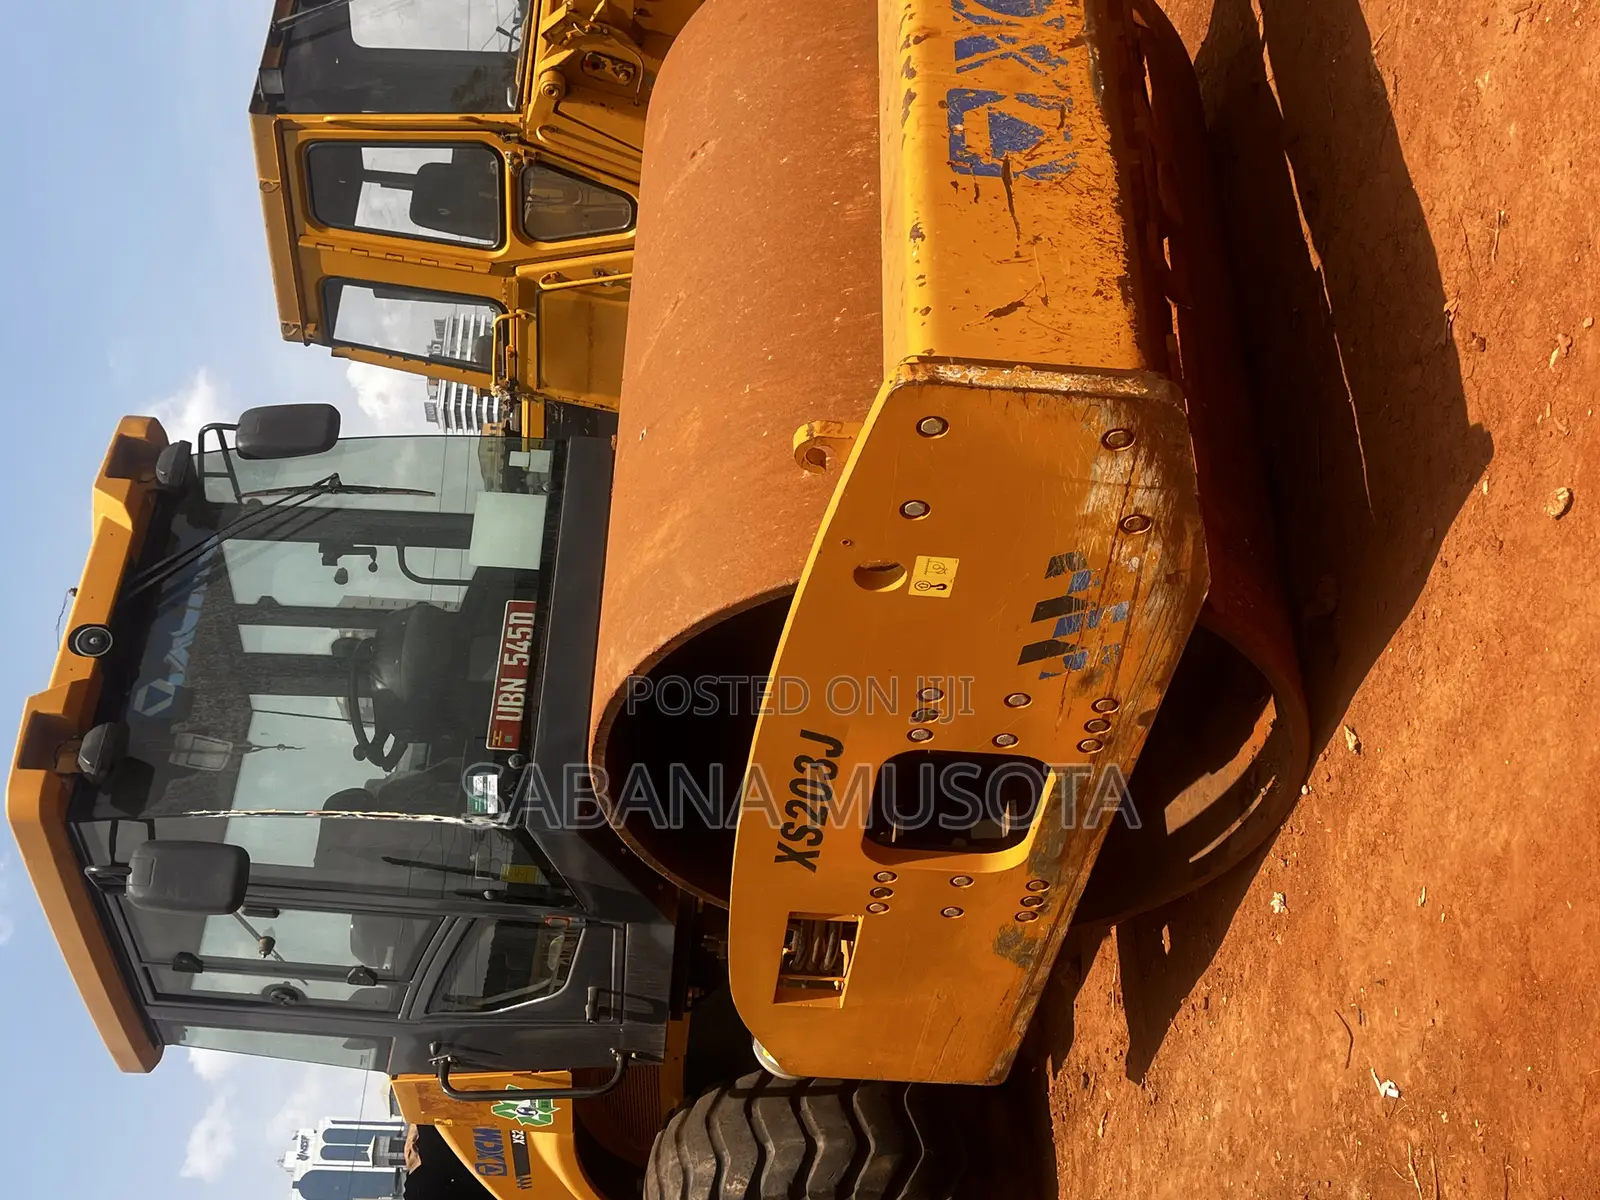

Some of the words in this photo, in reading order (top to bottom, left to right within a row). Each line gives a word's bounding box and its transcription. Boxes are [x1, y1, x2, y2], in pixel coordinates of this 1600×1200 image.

[504, 612, 535, 666] 545D
[496, 677, 527, 721] UBN
[774, 729, 844, 873] XS203J
